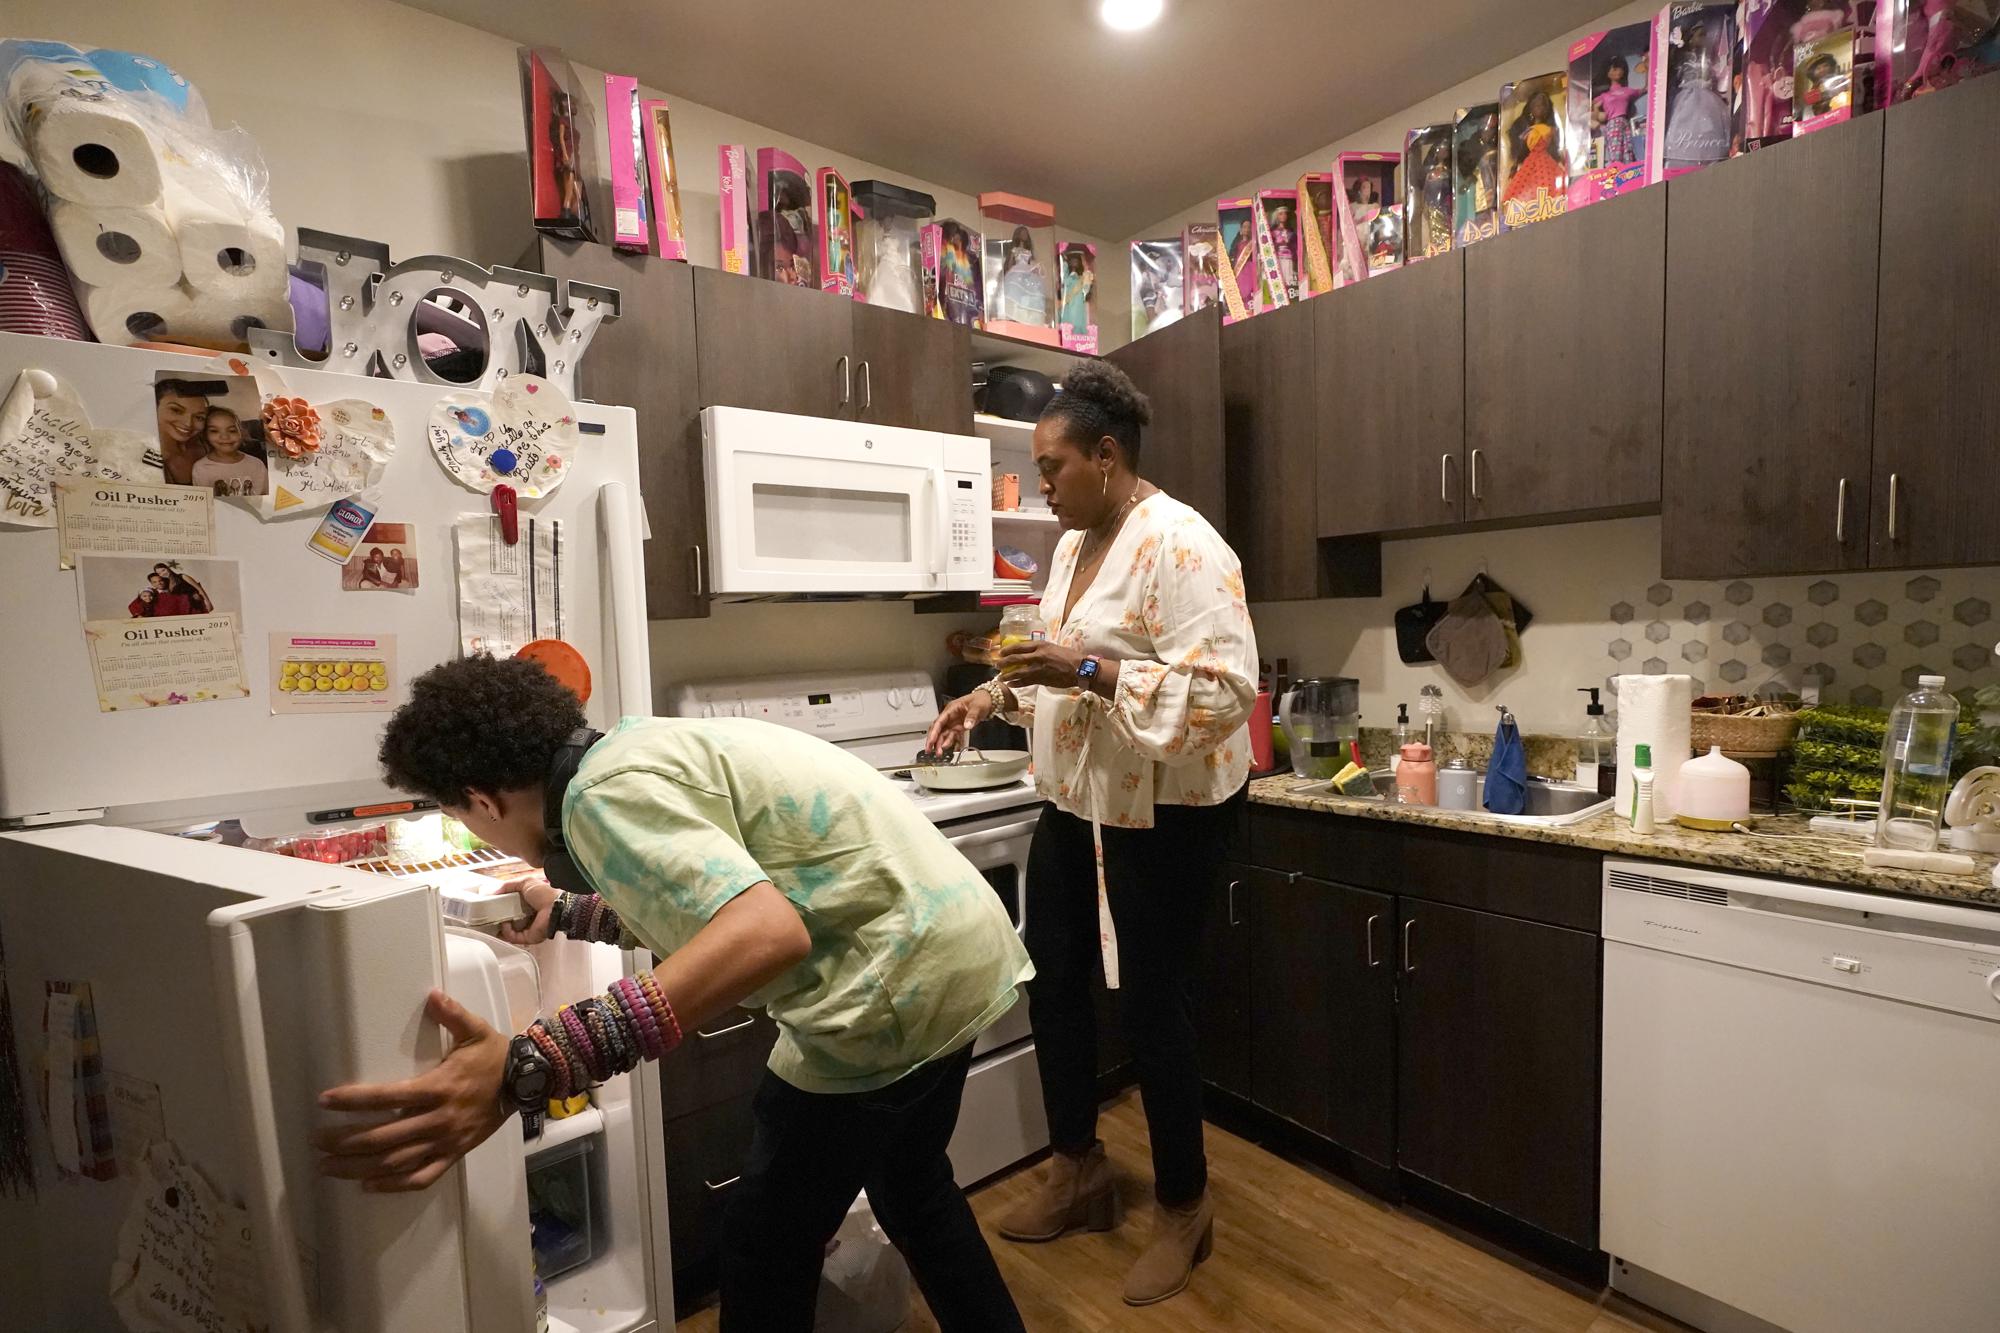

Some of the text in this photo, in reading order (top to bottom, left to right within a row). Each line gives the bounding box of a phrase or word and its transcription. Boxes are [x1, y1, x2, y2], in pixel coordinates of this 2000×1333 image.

[1672, 2, 1704, 20] Barbie
[27, 416, 56, 444] hope
[95, 490, 205, 506] Oil Pusher 2019
[337, 508, 364, 526] CLOROX
[124, 621, 229, 641] Oil Pusher 2019
